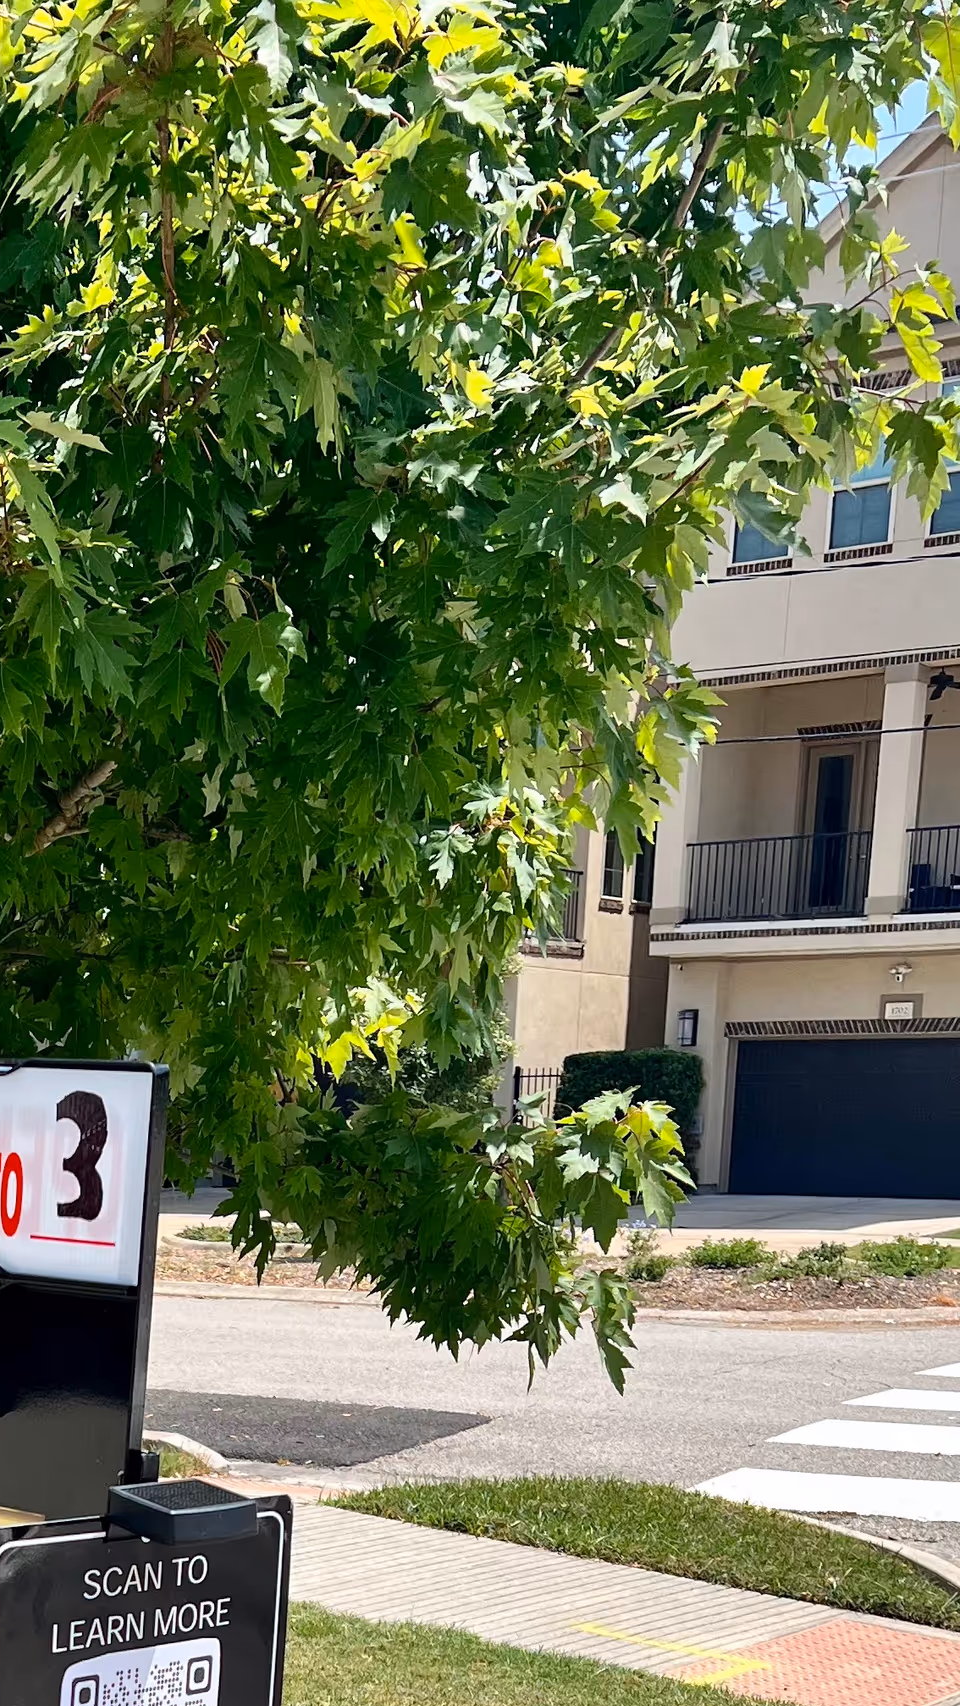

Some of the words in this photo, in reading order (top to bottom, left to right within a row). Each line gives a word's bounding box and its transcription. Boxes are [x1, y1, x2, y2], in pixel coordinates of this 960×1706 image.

[56, 1091, 107, 1222] 3
[83, 1561, 162, 1599] SCAN
[172, 1555, 208, 1586] TO
[52, 1611, 145, 1653] LEARN
[154, 1598, 231, 1637] MORE
